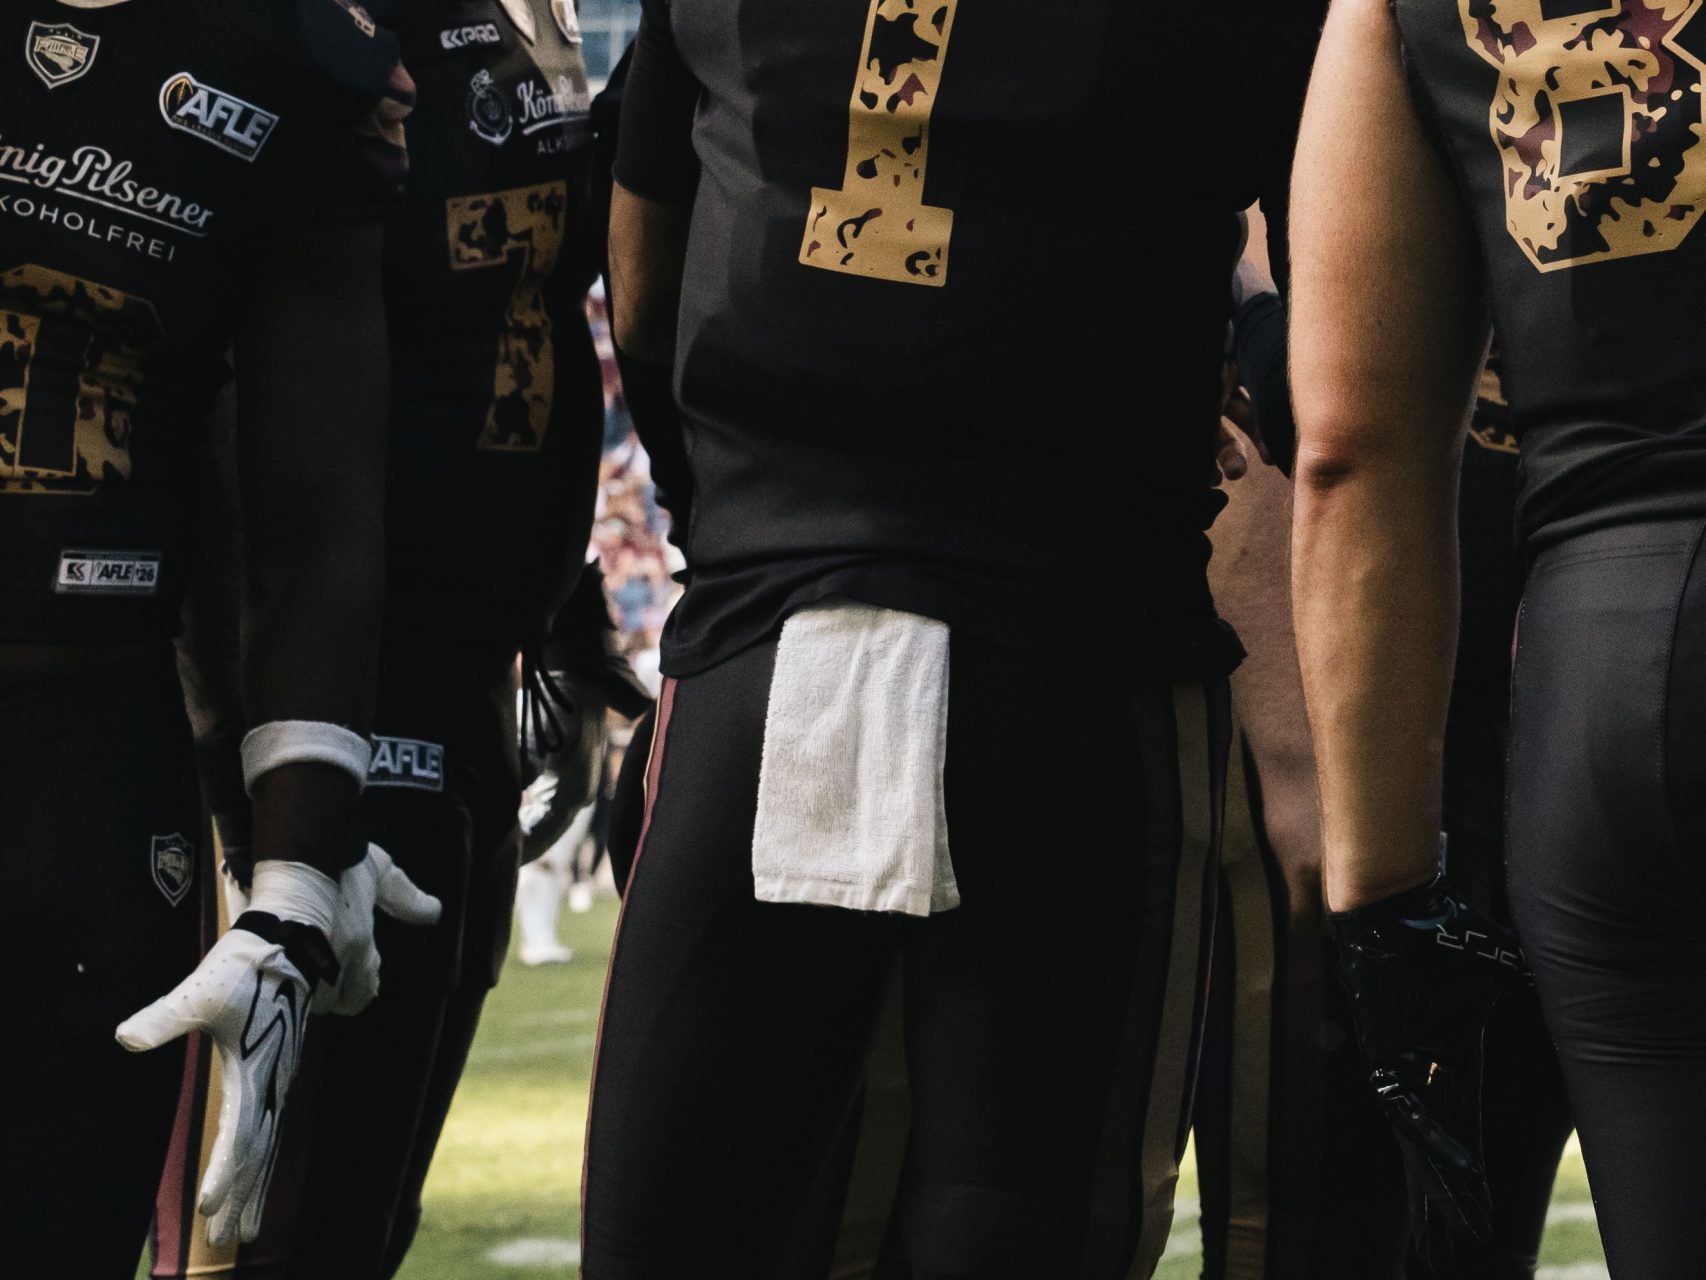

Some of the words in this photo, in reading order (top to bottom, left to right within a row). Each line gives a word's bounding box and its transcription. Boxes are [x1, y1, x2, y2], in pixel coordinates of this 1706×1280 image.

[176, 88, 271, 149] AFLE
[0, 141, 67, 188] nig
[62, 146, 213, 228] Pilsener
[97, 564, 134, 580] AFLE
[369, 741, 440, 779] AFLE
